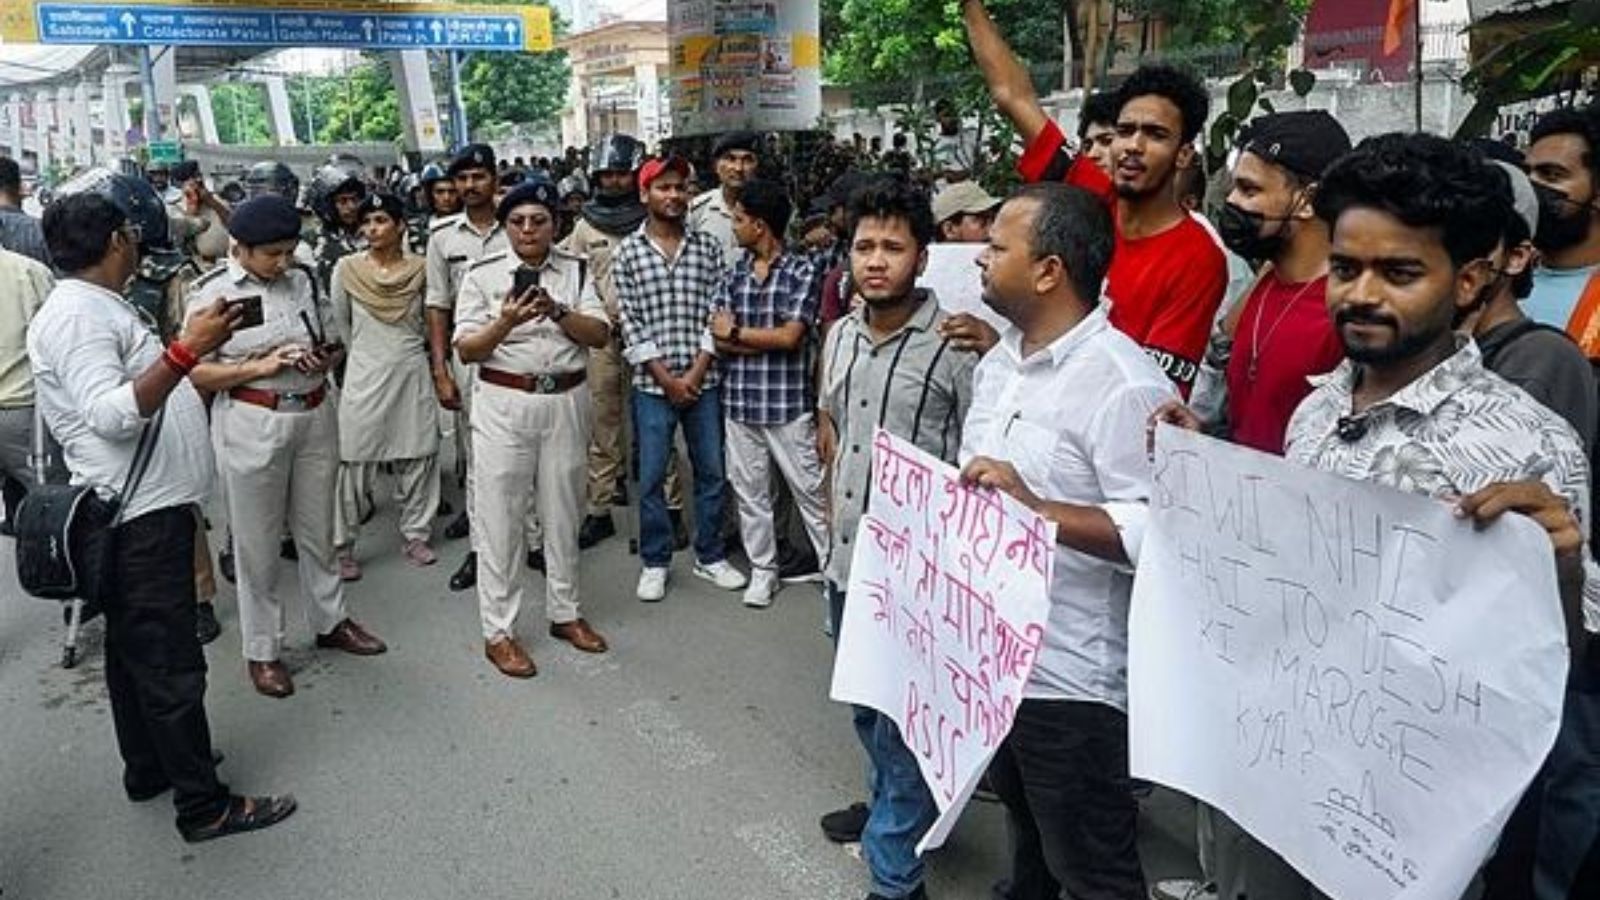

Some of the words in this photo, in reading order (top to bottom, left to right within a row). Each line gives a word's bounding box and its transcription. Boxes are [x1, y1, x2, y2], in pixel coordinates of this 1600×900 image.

[1155, 448, 1277, 557] BIWI
[1305, 492, 1438, 622] NHI
[1180, 536, 1252, 617] HAI
[1265, 577, 1329, 650] TO
[1351, 608, 1482, 726] DESH
[1200, 617, 1235, 665] KI
[1270, 648, 1440, 794] MAROGE
